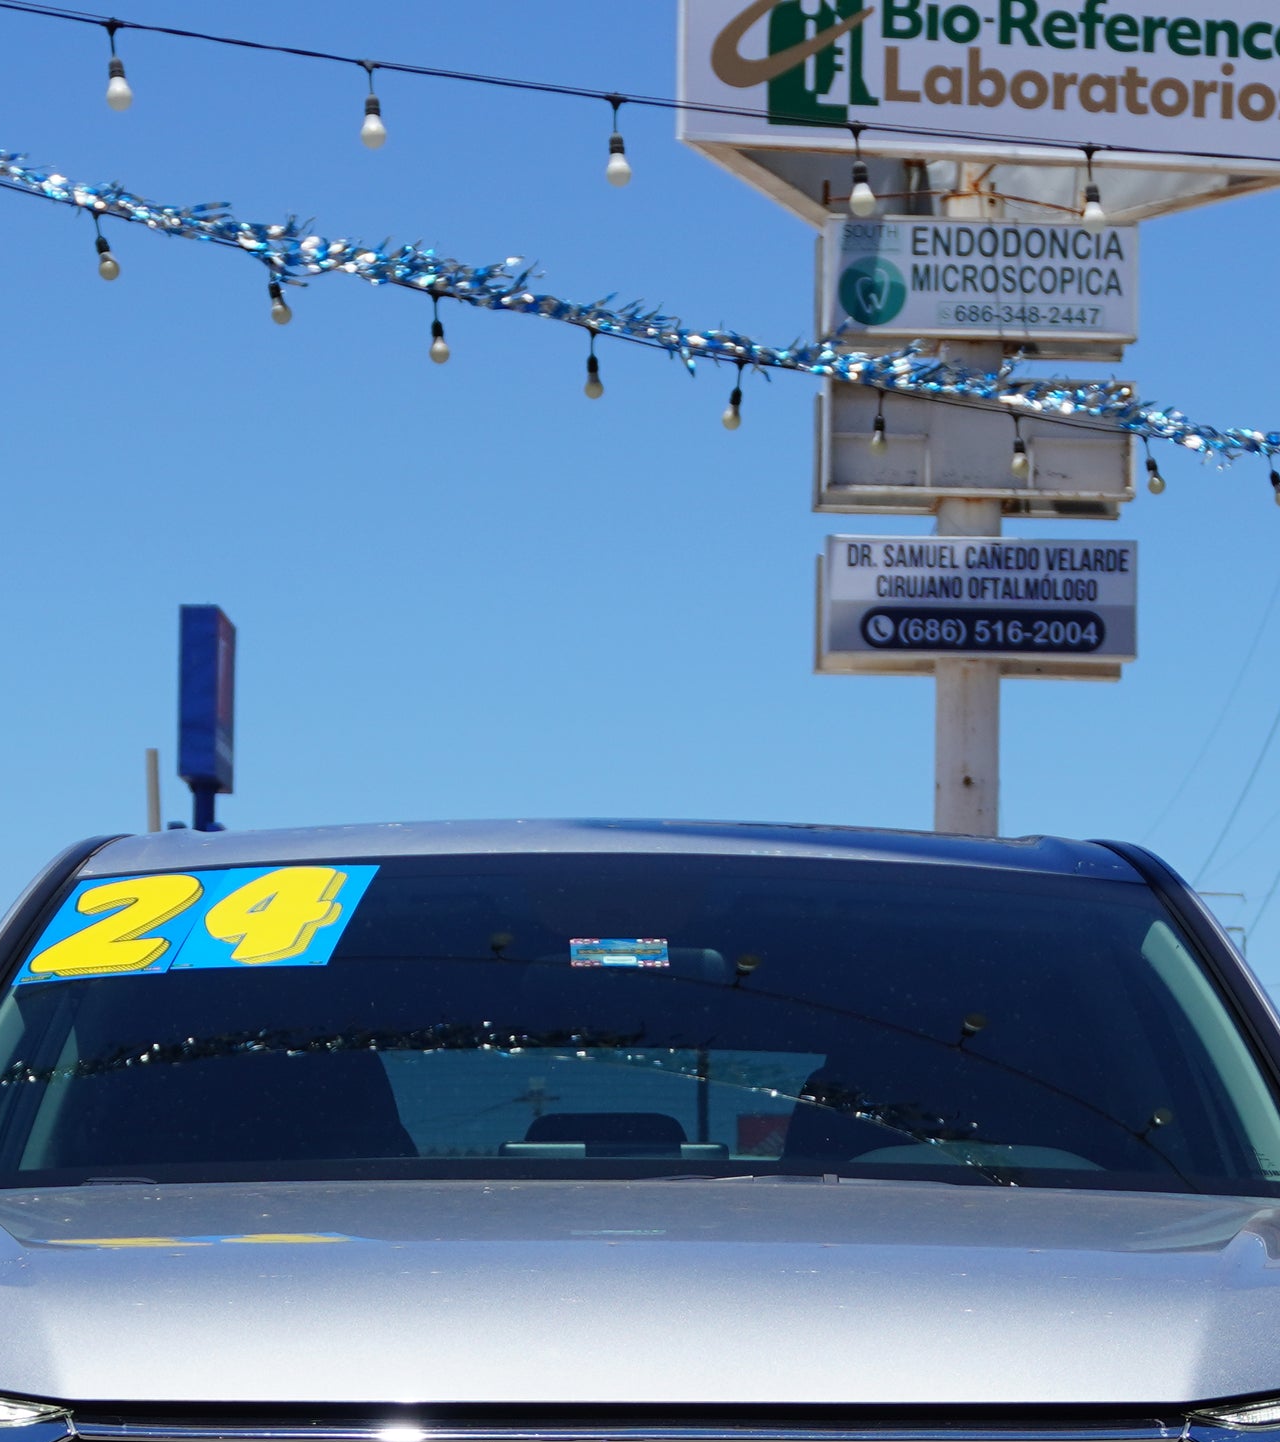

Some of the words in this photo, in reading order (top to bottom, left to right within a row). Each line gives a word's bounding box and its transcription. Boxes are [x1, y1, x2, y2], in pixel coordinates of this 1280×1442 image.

[843, 224, 898, 239] SOUTH
[911, 225, 1124, 262] ENDODONCIA
[910, 263, 1123, 297] MICROSCOPICA
[954, 304, 1102, 326] 686-348-2447
[847, 543, 878, 568] DR.
[883, 544, 960, 570] SAMUEL
[965, 542, 1039, 571] CAÑEDO
[1044, 548, 1130, 573] VELARDE
[876, 574, 963, 600] CIRUJANO
[969, 573, 1098, 602] OFTALMÓLOGO
[898, 617, 968, 646] (686)
[974, 618, 1099, 645] 516-2004
[29, 867, 347, 976] 24
